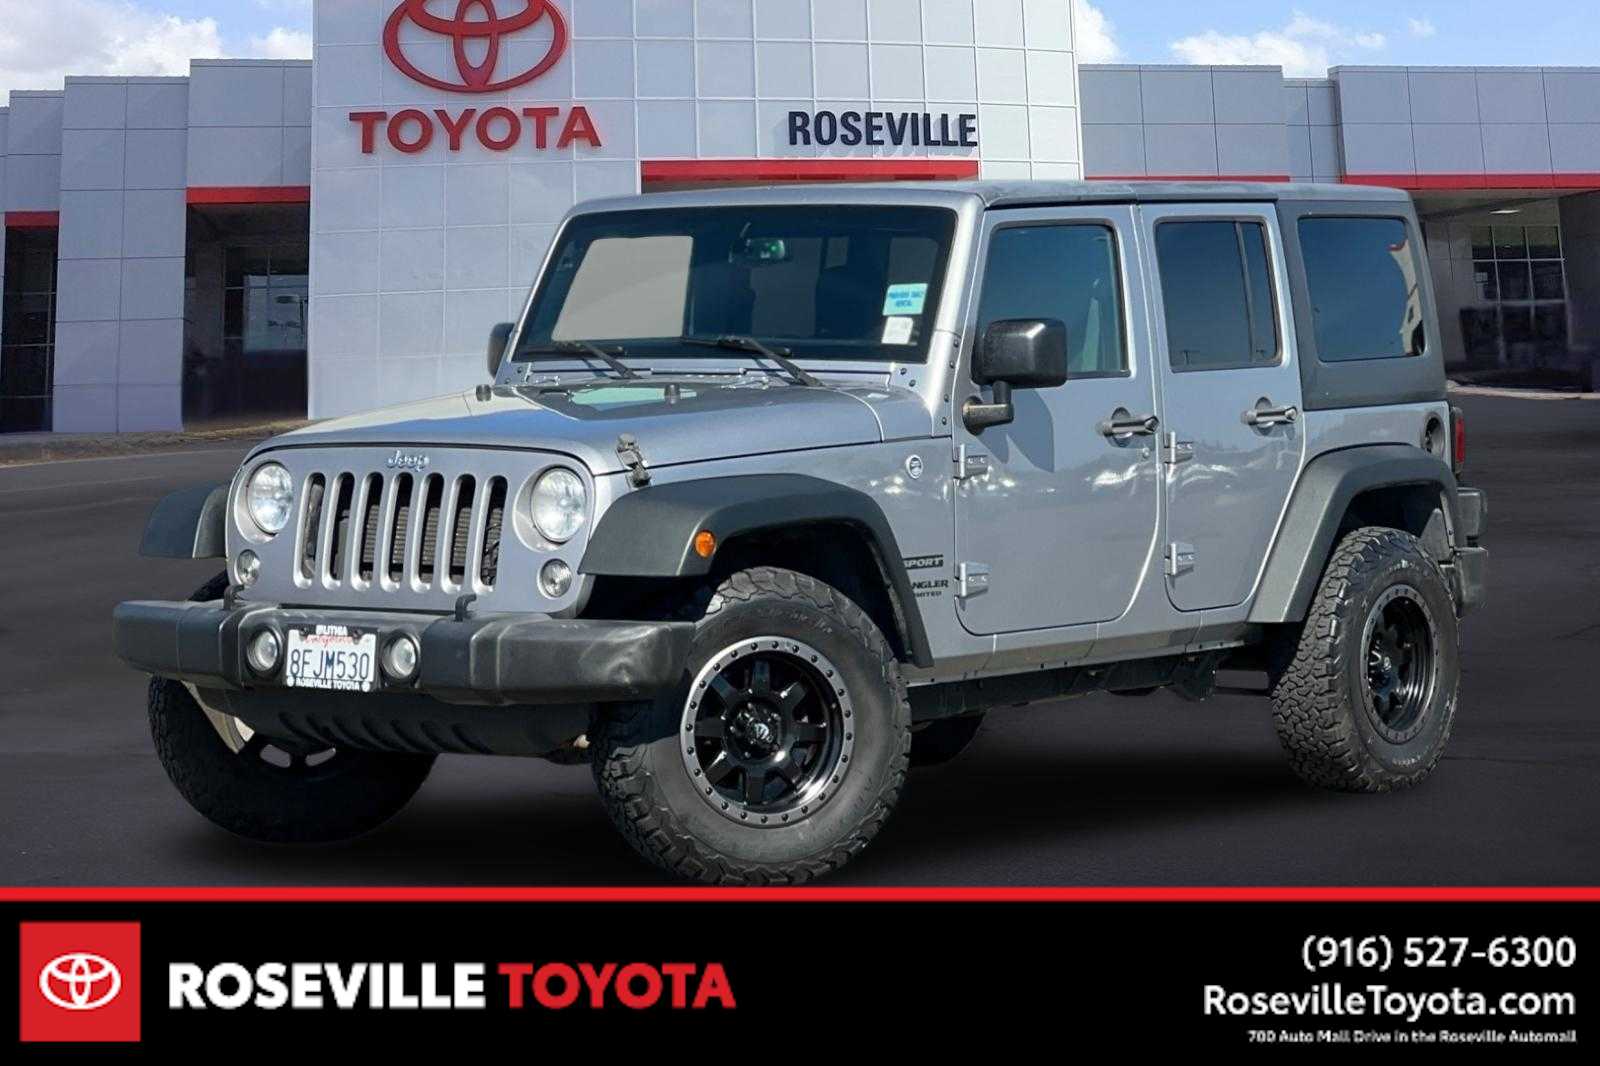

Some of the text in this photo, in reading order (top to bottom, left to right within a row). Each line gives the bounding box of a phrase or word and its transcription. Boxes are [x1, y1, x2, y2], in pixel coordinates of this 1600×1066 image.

[349, 106, 602, 154] TOYOTA
[788, 110, 978, 147] ROSEVILLE
[387, 449, 430, 473] Jeep
[912, 580, 949, 590] NGLER
[290, 649, 370, 681] 8FJM530
[295, 678, 360, 691] ROSEVILLE TOYOTA
